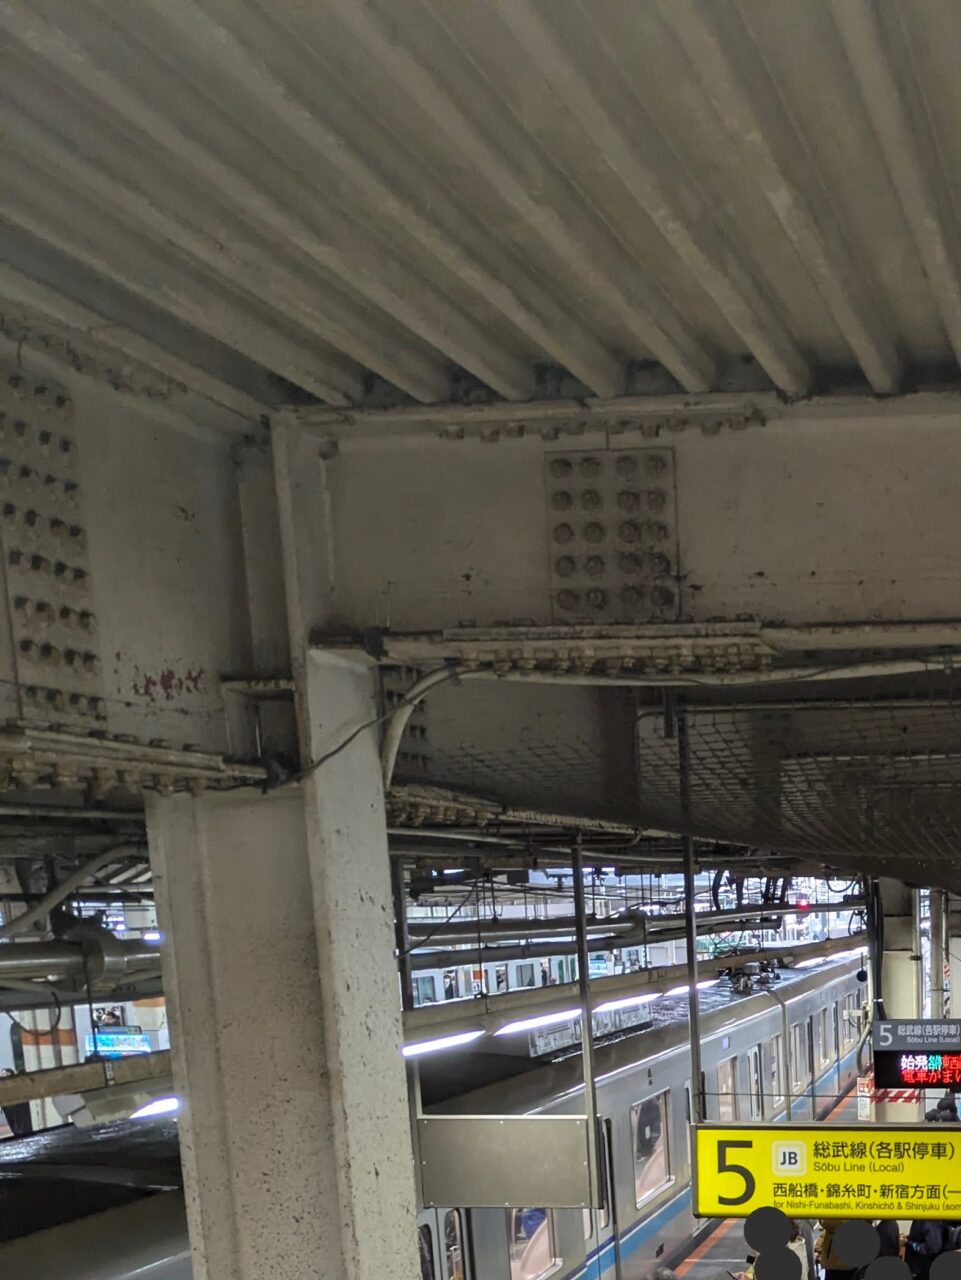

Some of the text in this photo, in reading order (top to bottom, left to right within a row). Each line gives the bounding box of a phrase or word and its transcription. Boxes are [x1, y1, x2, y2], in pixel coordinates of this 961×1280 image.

[880, 1024, 893, 1046] 5
[780, 1151, 798, 1166] JB
[813, 1141, 955, 1160] 総武線(各駅停車)
[717, 1140, 755, 1206] 5
[813, 1162, 904, 1173] Sōbu Line (Local)
[786, 1201, 853, 1210] Nishi-Funabashi,
[906, 1203, 939, 1212] Shinjuku
